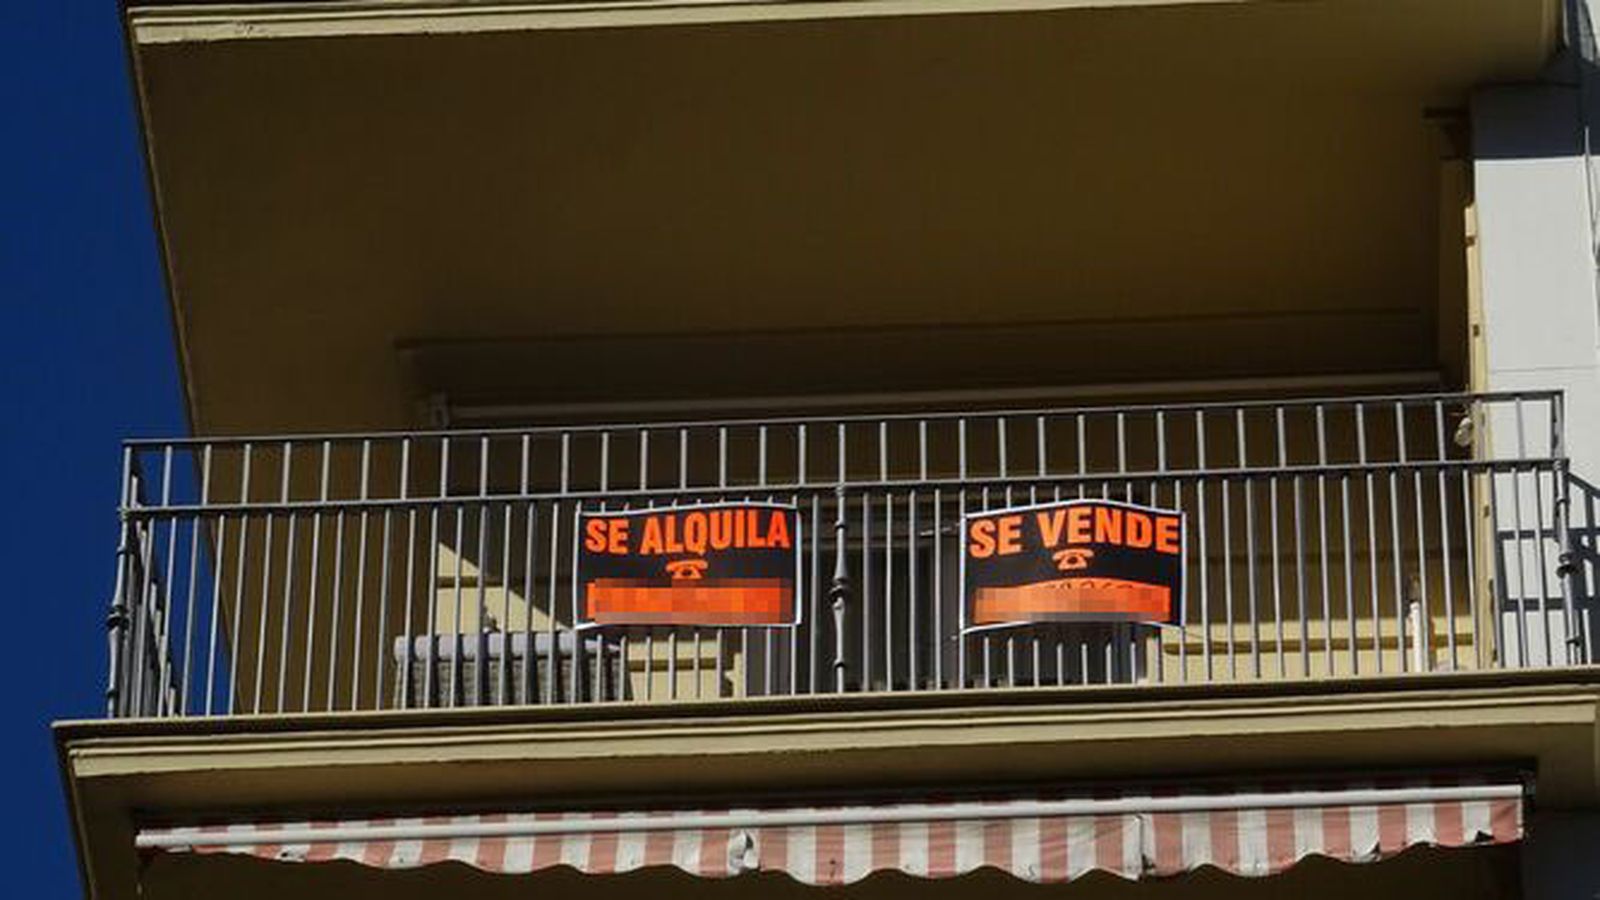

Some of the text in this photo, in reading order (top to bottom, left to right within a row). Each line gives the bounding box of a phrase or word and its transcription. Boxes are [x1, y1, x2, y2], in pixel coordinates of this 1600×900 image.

[584, 508, 791, 556] SE ALQUILA
[969, 506, 1180, 558] SE VENDE
